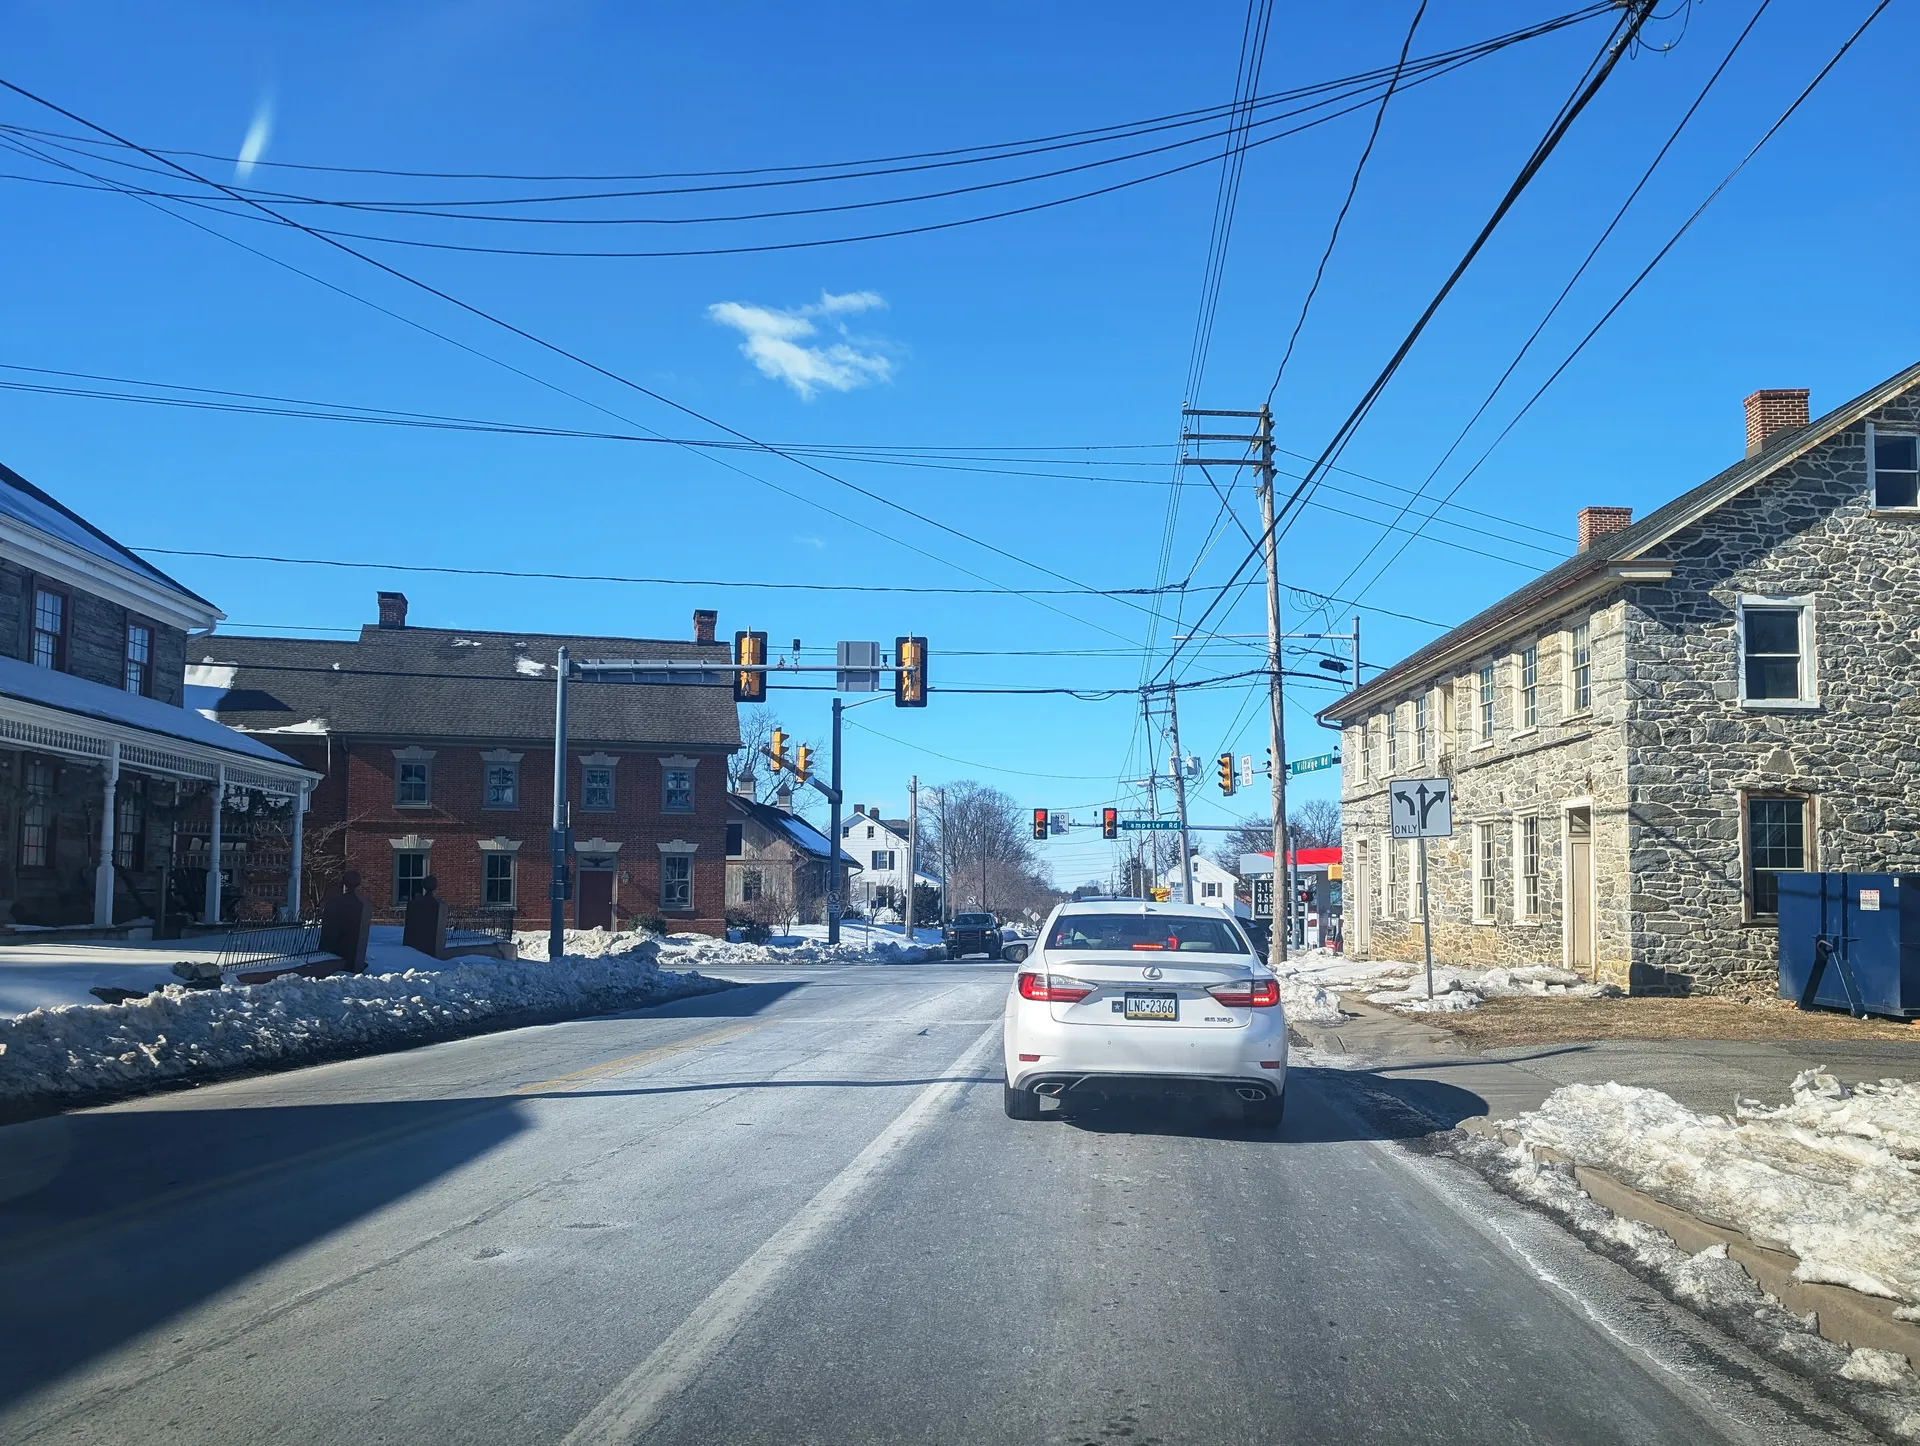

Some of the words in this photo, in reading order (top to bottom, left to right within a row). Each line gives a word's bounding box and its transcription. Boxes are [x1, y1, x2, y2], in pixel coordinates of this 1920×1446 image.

[1297, 760, 1318, 771] Village
[1321, 756, 1328, 766] Rd
[1395, 824, 1417, 835] ONLY
[1258, 883, 1273, 892] 3.15
[1258, 894, 1273, 903] 3.55
[1258, 905, 1273, 914] 4.05
